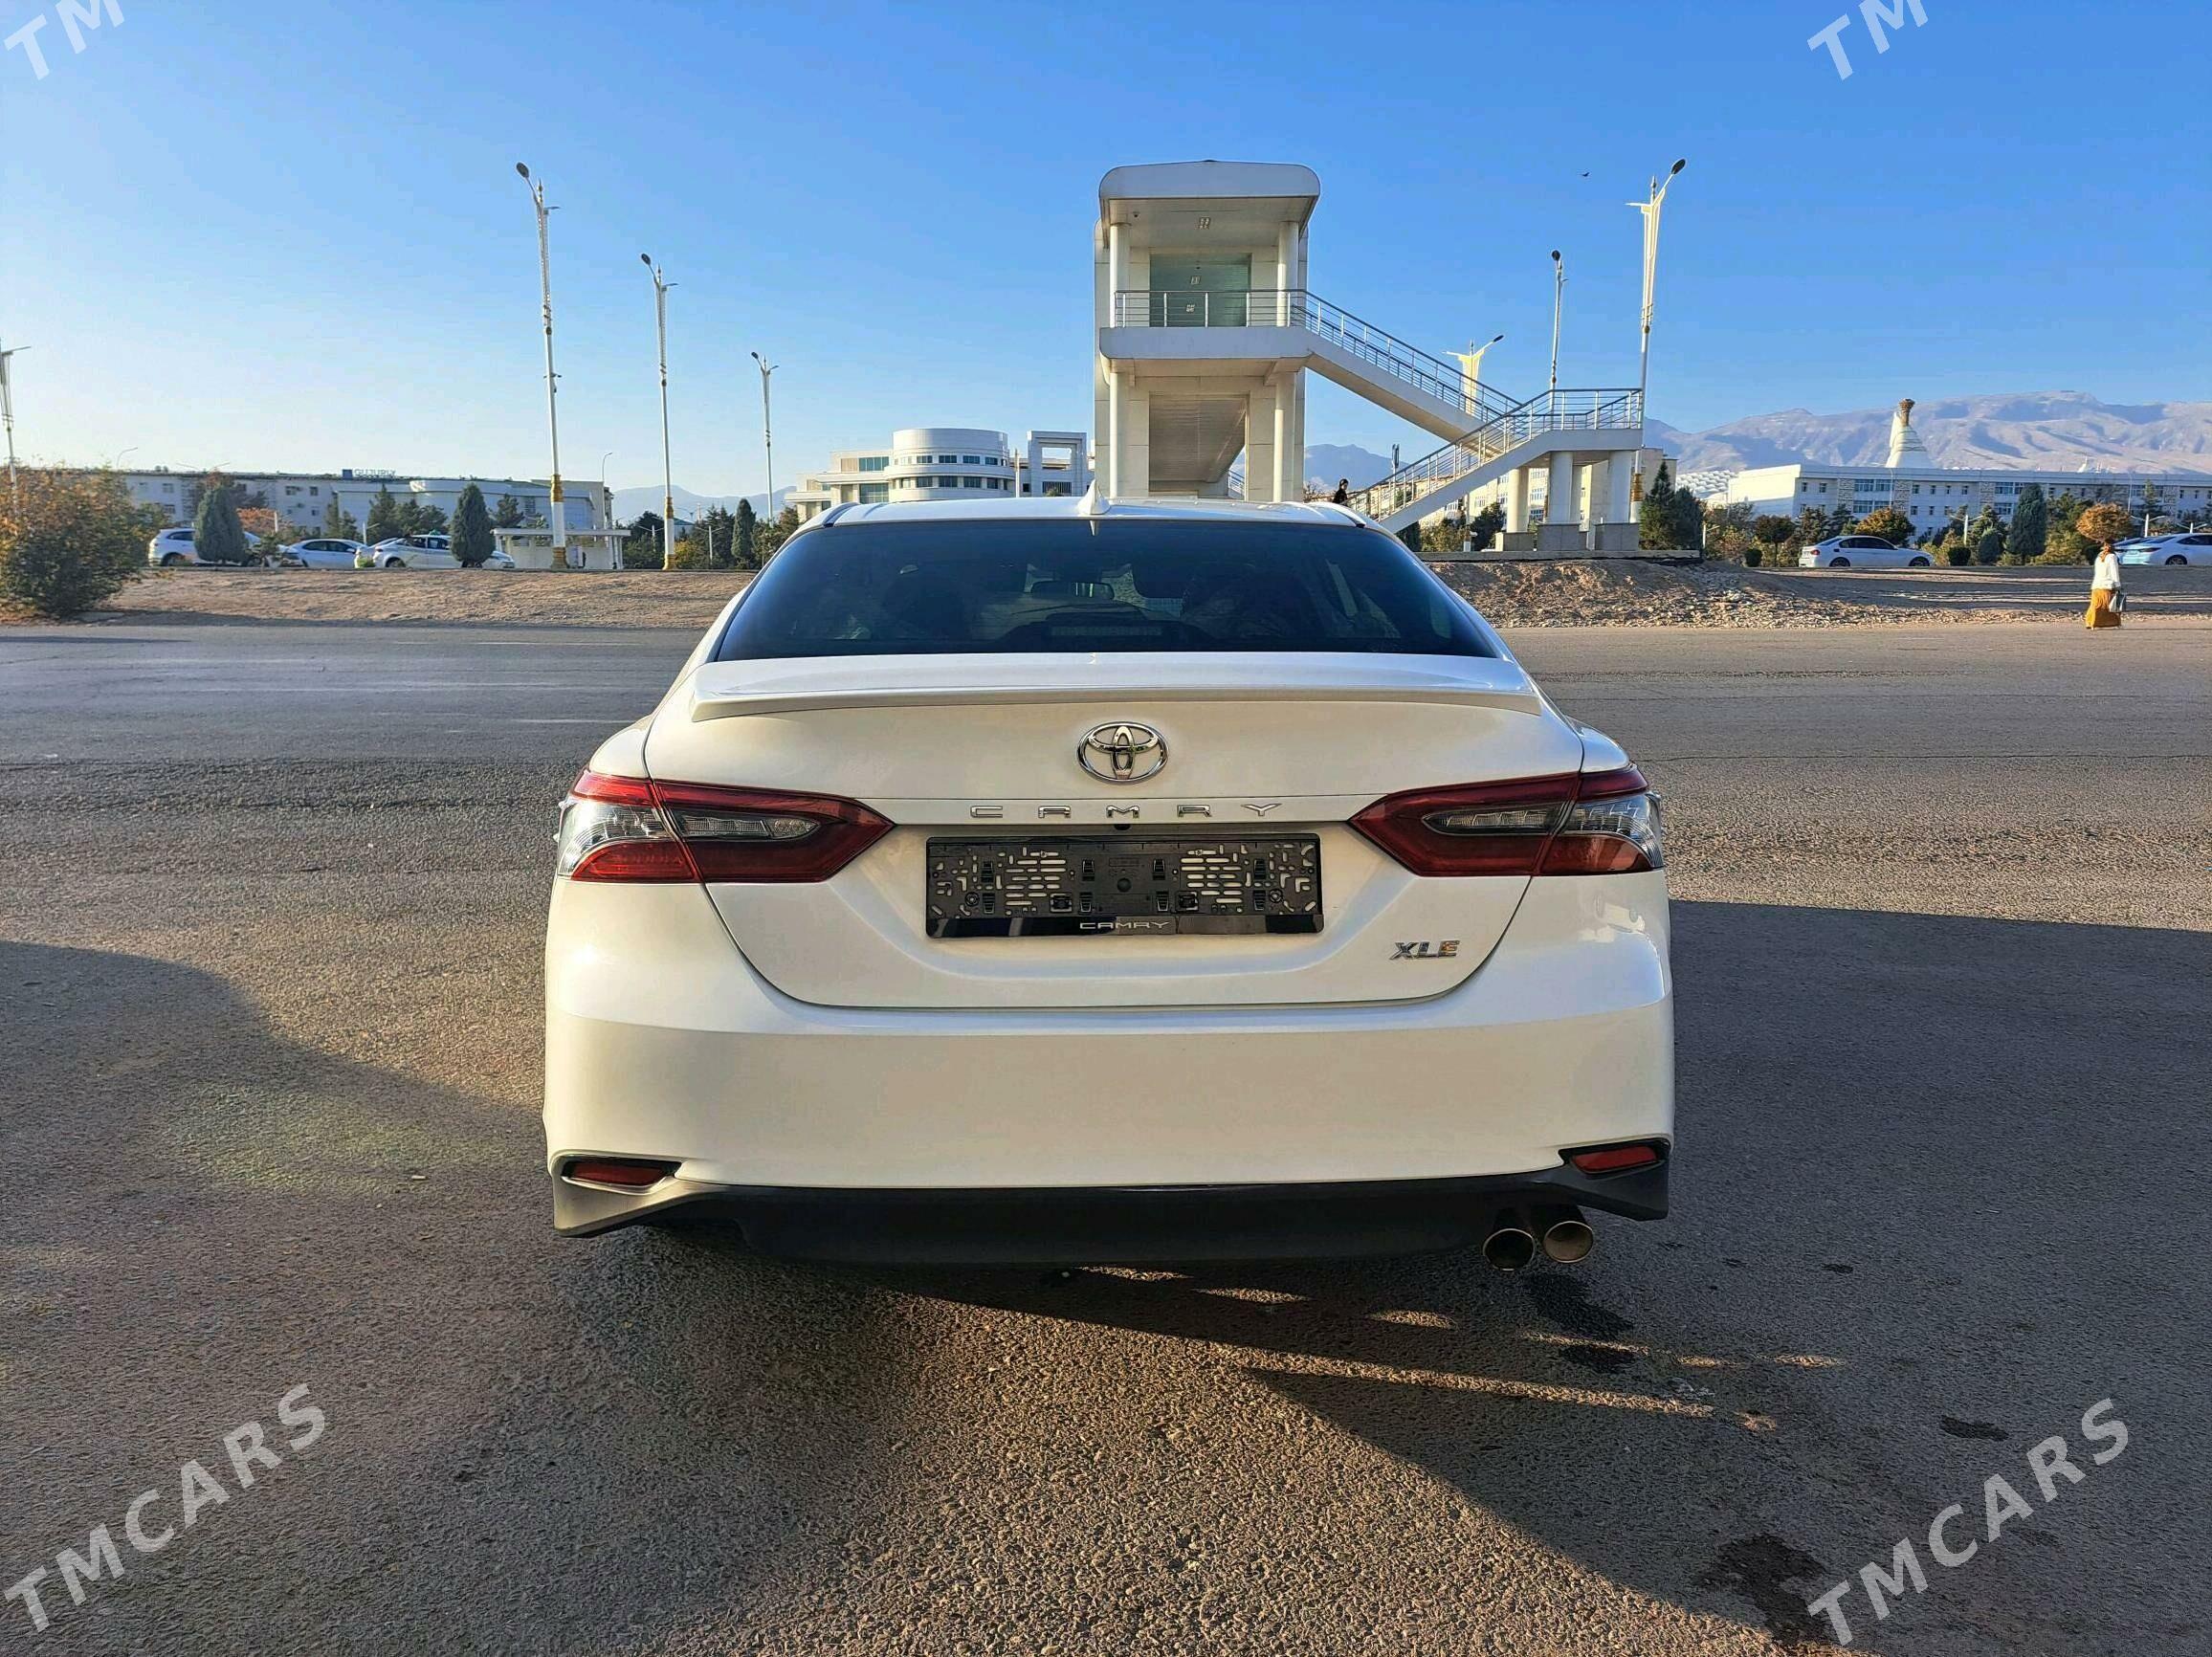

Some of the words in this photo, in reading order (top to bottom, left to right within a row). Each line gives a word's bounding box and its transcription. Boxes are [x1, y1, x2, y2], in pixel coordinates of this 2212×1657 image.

[969, 804, 1282, 819] CAMRY
[1079, 921, 1170, 930] CAMRY
[1389, 939, 1461, 961] XLE
